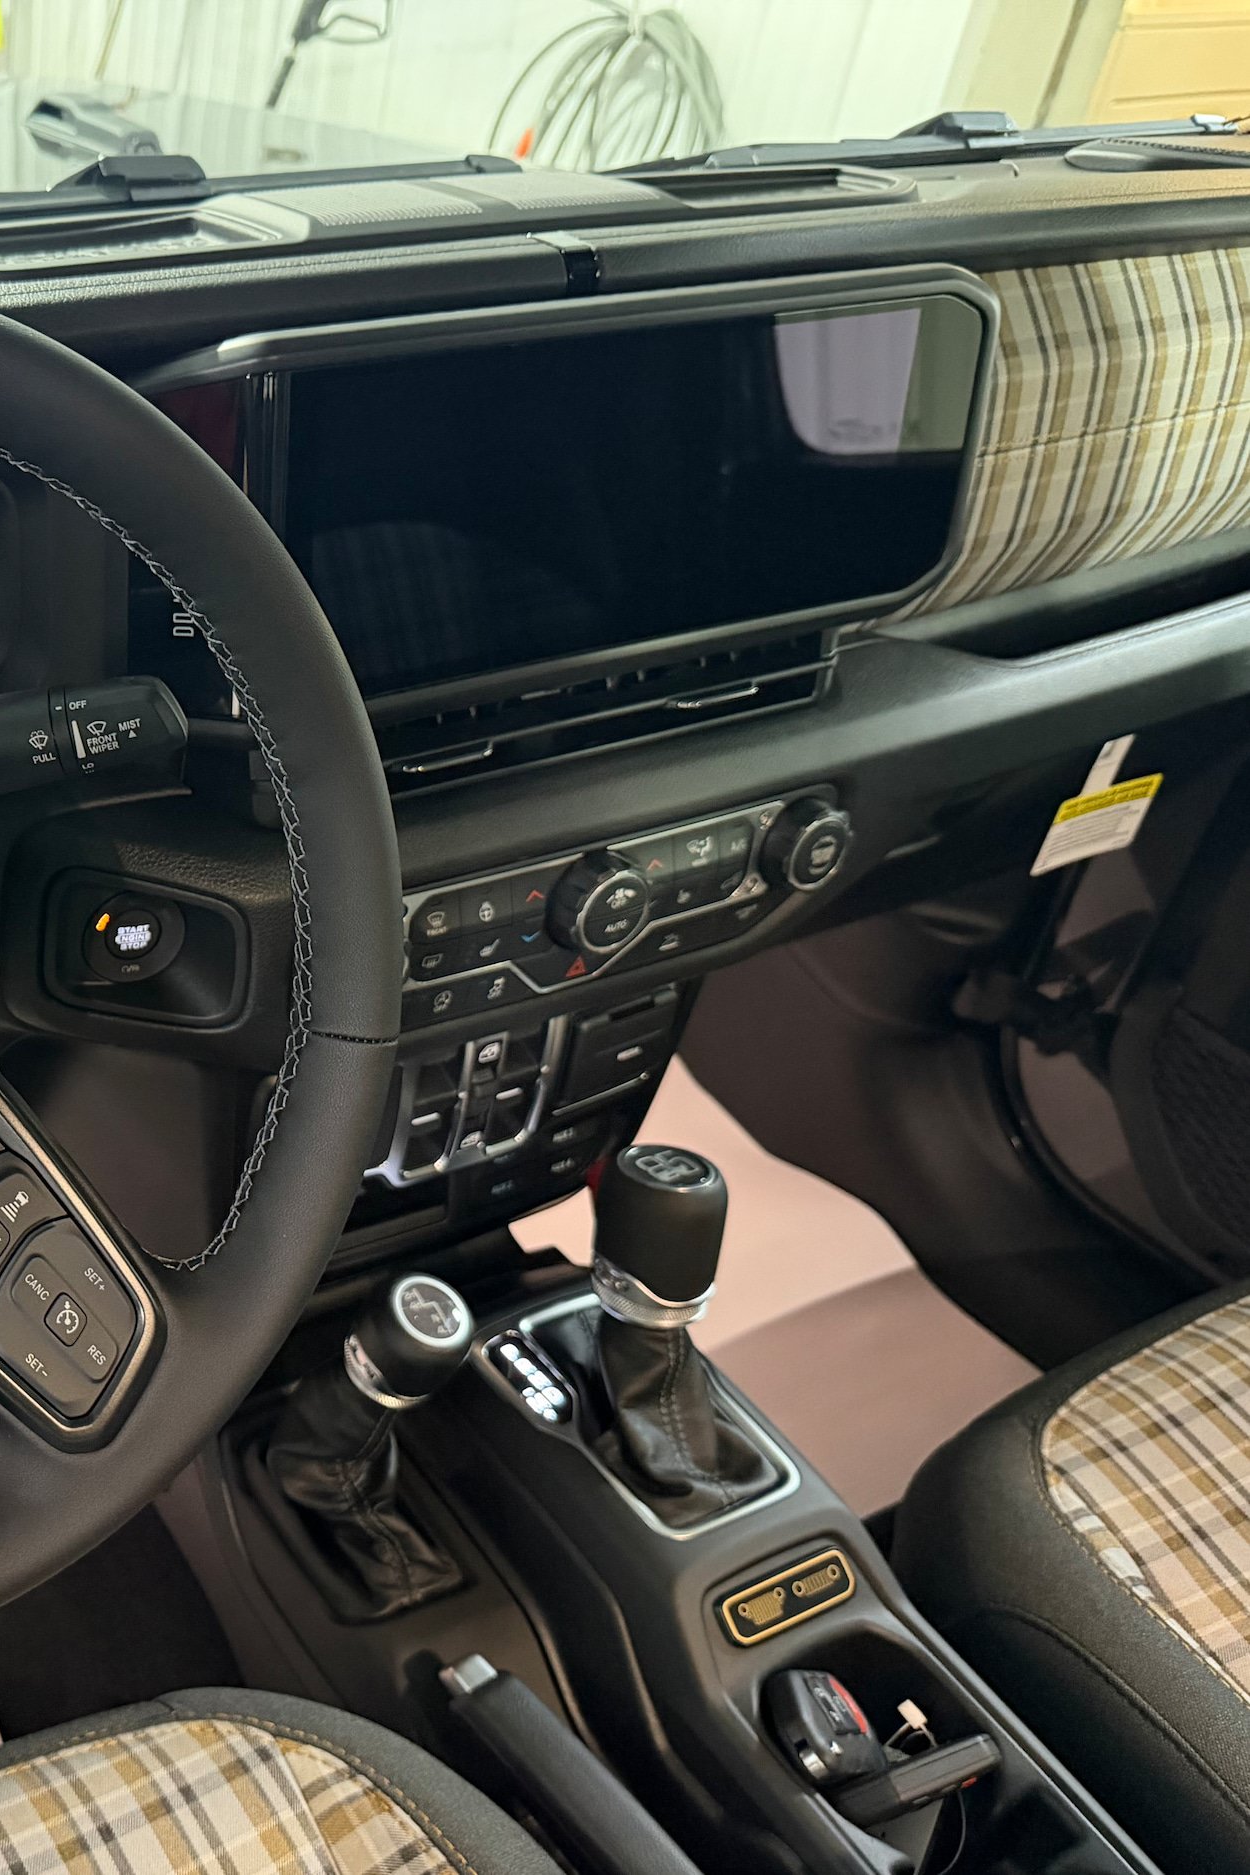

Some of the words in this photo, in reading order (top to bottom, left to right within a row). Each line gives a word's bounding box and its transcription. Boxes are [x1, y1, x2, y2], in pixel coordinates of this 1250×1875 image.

[68, 700, 87, 711] OFF
[118, 718, 141, 732] MIST
[86, 732, 117, 747] FRONT
[89, 741, 120, 755] WIPER
[32, 752, 56, 764] PULL
[604, 918, 628, 933] AUTO
[24, 1273, 50, 1301] CANC
[87, 1344, 107, 1366] RES
